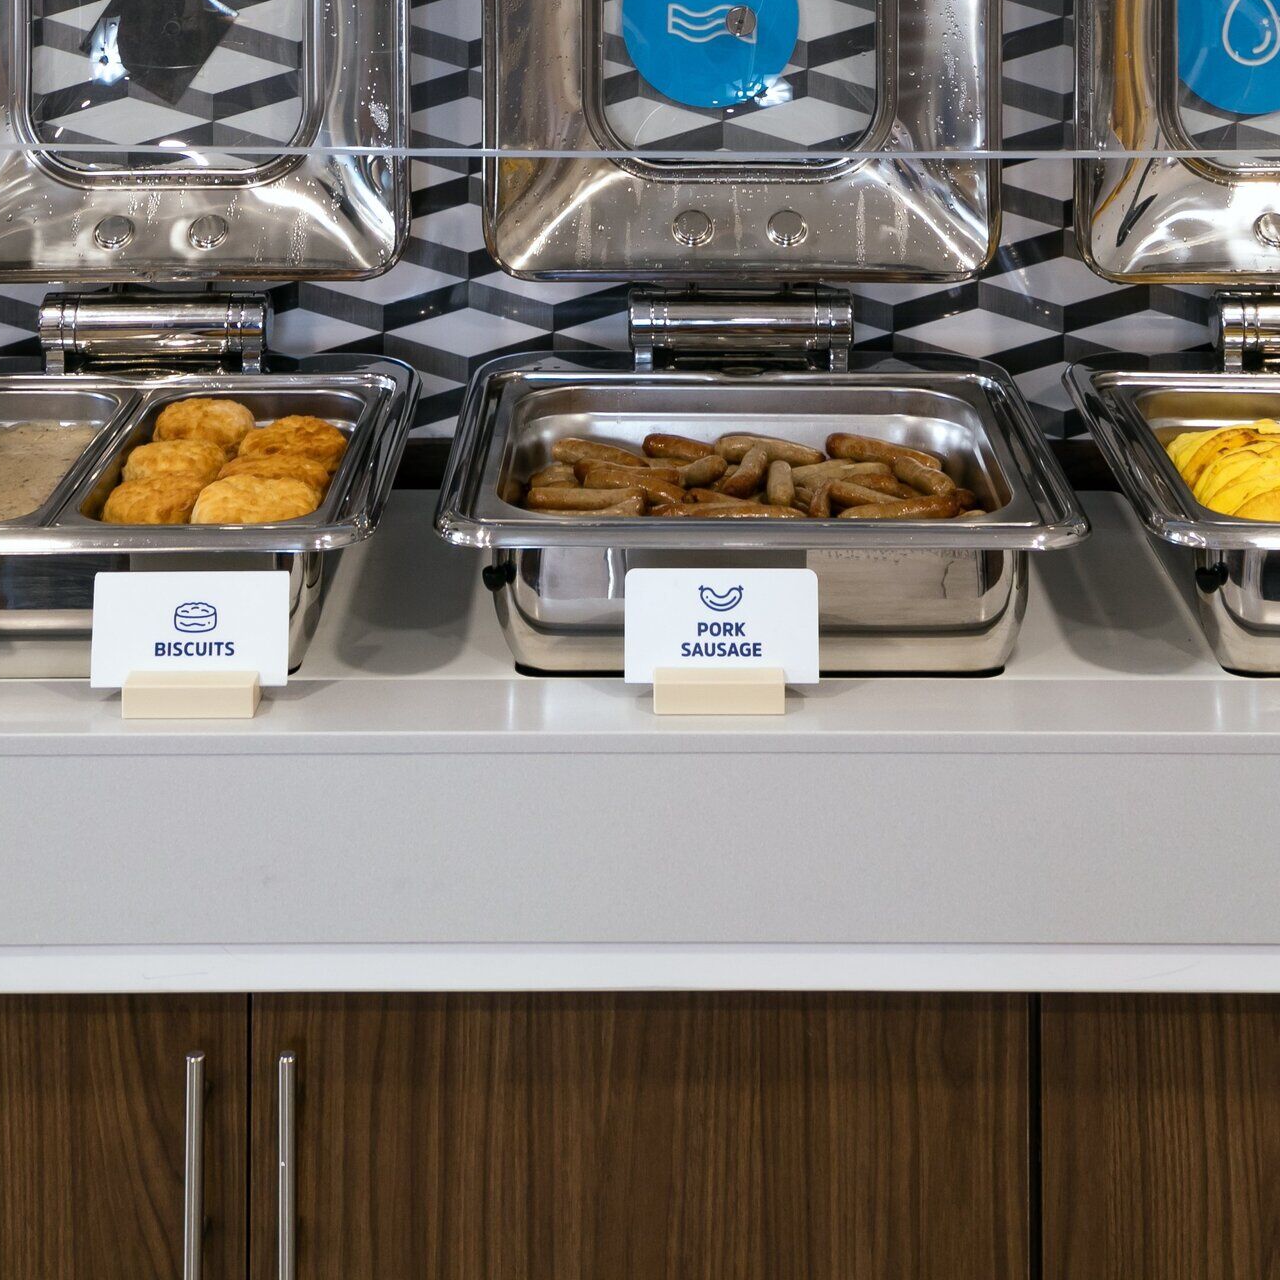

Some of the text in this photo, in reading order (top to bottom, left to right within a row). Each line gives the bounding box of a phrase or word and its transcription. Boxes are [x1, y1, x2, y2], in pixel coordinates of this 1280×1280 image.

[697, 622, 746, 637] PORK
[154, 641, 235, 657] BISCUITS
[681, 642, 762, 657] SAUSAGE
